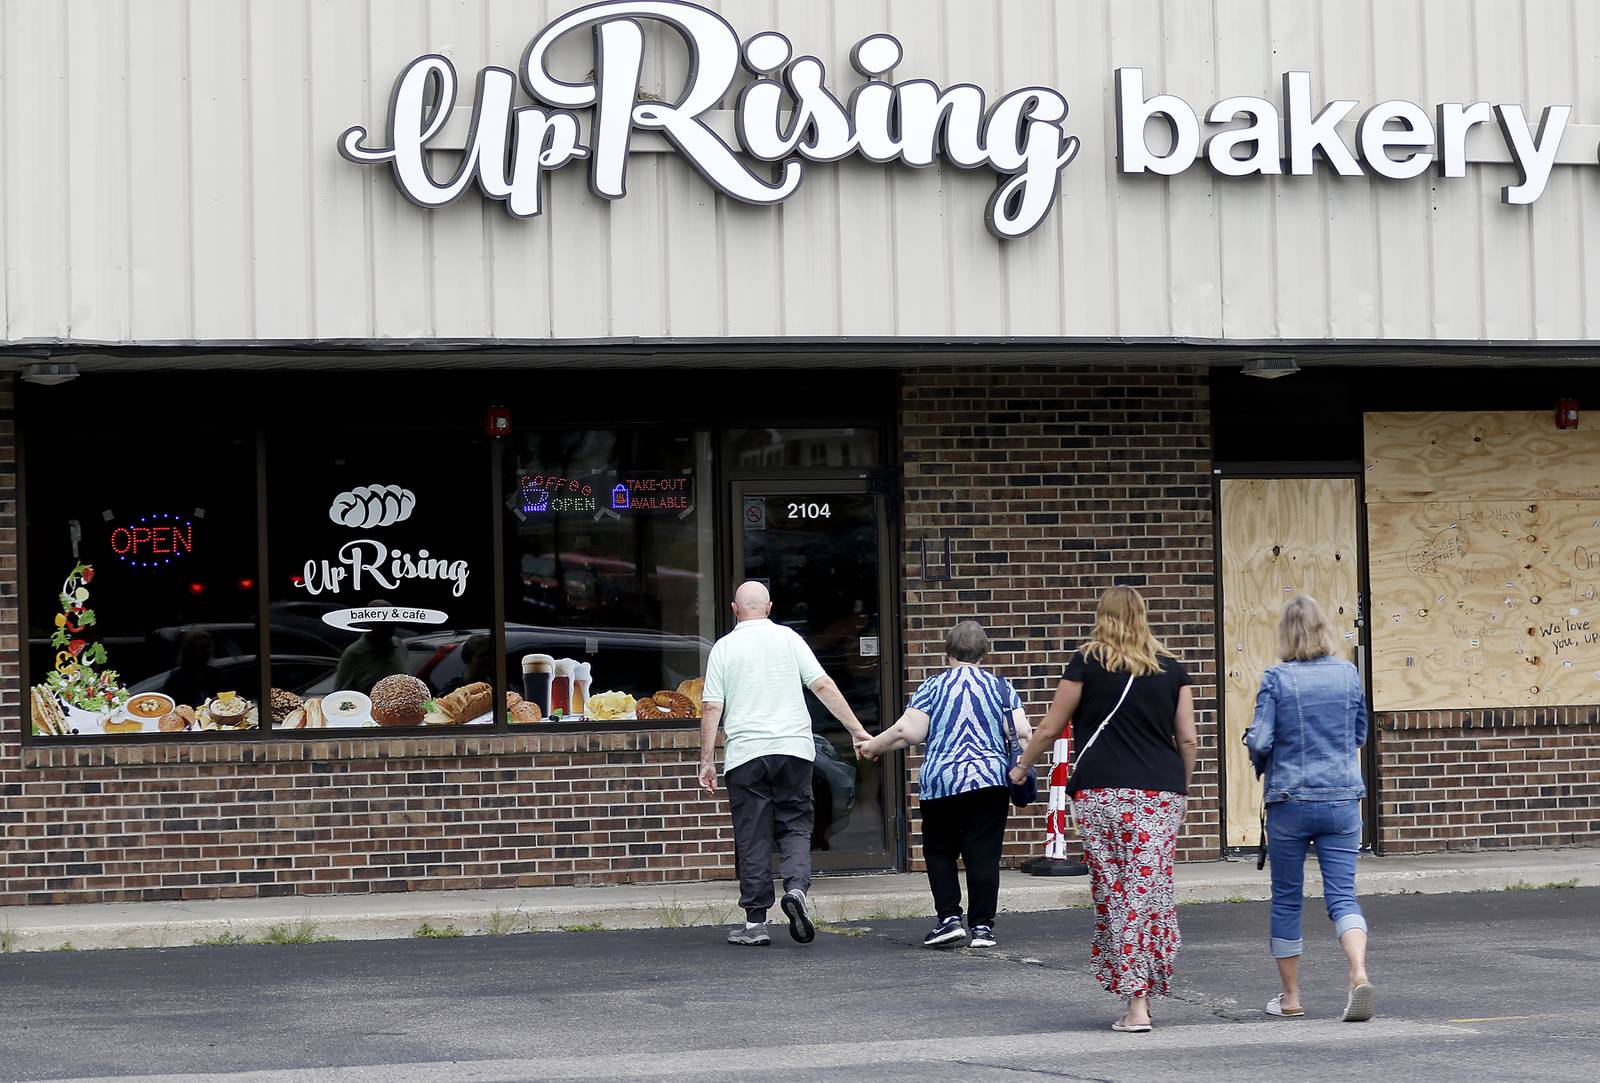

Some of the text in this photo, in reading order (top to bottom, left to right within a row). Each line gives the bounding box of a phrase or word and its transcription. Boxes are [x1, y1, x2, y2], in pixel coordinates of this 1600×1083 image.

[338, 0, 1573, 240] UpRising bakery
[626, 479, 686, 491] TAKE-OUT
[551, 498, 595, 511] OPEN
[630, 496, 687, 509] AVAILABLE
[787, 503, 831, 519] 2104
[111, 526, 192, 554] OPEN
[294, 539, 470, 597] UpRising
[350, 609, 426, 620] bakery & café
[1540, 619, 1590, 638] We love
[1552, 635, 1579, 654] you,
